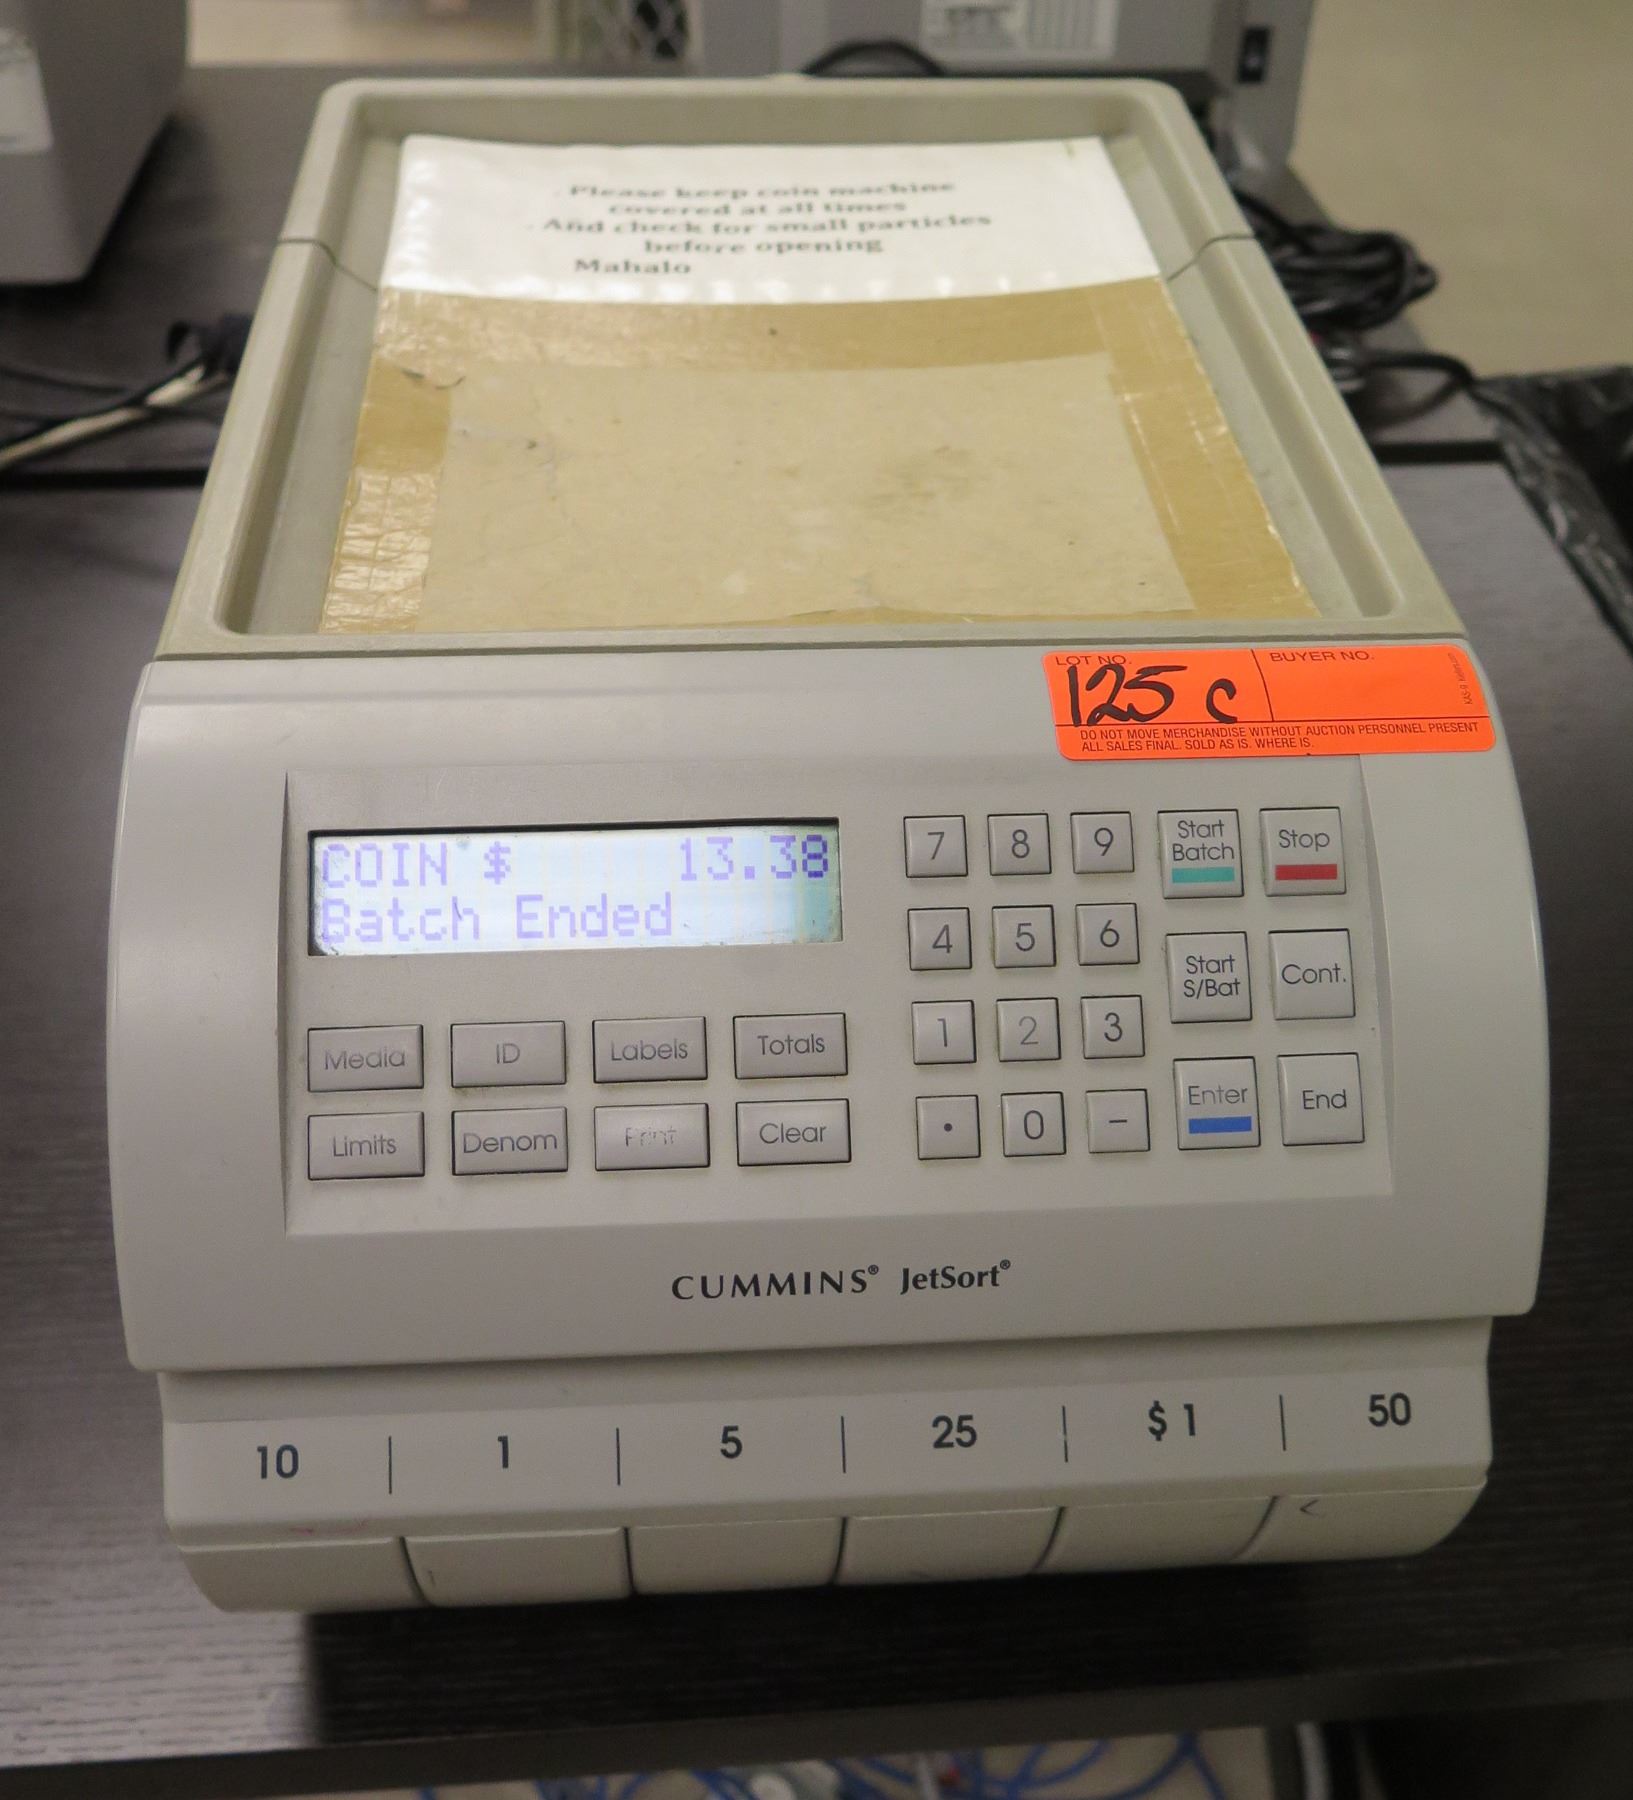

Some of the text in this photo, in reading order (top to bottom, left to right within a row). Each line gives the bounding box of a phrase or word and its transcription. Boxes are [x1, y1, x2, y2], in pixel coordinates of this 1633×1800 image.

[571, 181, 955, 199] Please keep coin machine
[609, 202, 907, 215] covered at all times
[543, 212, 991, 233] And check for small particles
[644, 238, 884, 254] before opening
[574, 259, 691, 274] Mahalo
[1056, 654, 1132, 665] LOT NO.
[1271, 650, 1375, 662] BUYER NO.
[1067, 663, 1188, 727] 125
[1081, 721, 1479, 740] DO NOT MOVE MERCHANDISE WITHOUT AUCTION PERSONNEL PRESENT
[1082, 735, 1315, 751] ALL SALES FINAL. SOLD AS IS. WHERE IS.
[1178, 820, 1225, 838] Start
[1278, 829, 1331, 850] Stop
[927, 832, 945, 860] 7
[1012, 830, 1031, 859] 8
[1094, 828, 1114, 857] 9
[1172, 843, 1235, 861] Batch
[322, 834, 829, 888] COIN $ 13.38
[322, 892, 671, 943] Batch Ended
[932, 925, 953, 954] 4
[1015, 923, 1036, 952] 5
[1100, 920, 1120, 948] 6
[1186, 956, 1236, 974] Start
[1281, 963, 1346, 985] Cont.
[1184, 979, 1241, 998] S/Bat
[937, 1018, 949, 1048] 1
[1019, 1016, 1038, 1046] 2
[1104, 1013, 1123, 1042] 3
[496, 1043, 521, 1064] ID
[611, 1037, 689, 1062] Labels
[757, 1033, 826, 1056] Totals
[324, 1046, 406, 1070] Media
[1189, 1085, 1248, 1105] Enter
[1303, 1089, 1347, 1110] End
[463, 1131, 558, 1154] Denom
[759, 1120, 828, 1146] Clear
[332, 1132, 397, 1159] Limits
[257, 1445, 299, 1479] 10
[498, 1435, 509, 1469] 1
[720, 1425, 742, 1459] 5
[931, 1415, 977, 1448] 25
[1369, 1392, 1411, 1426] 50
